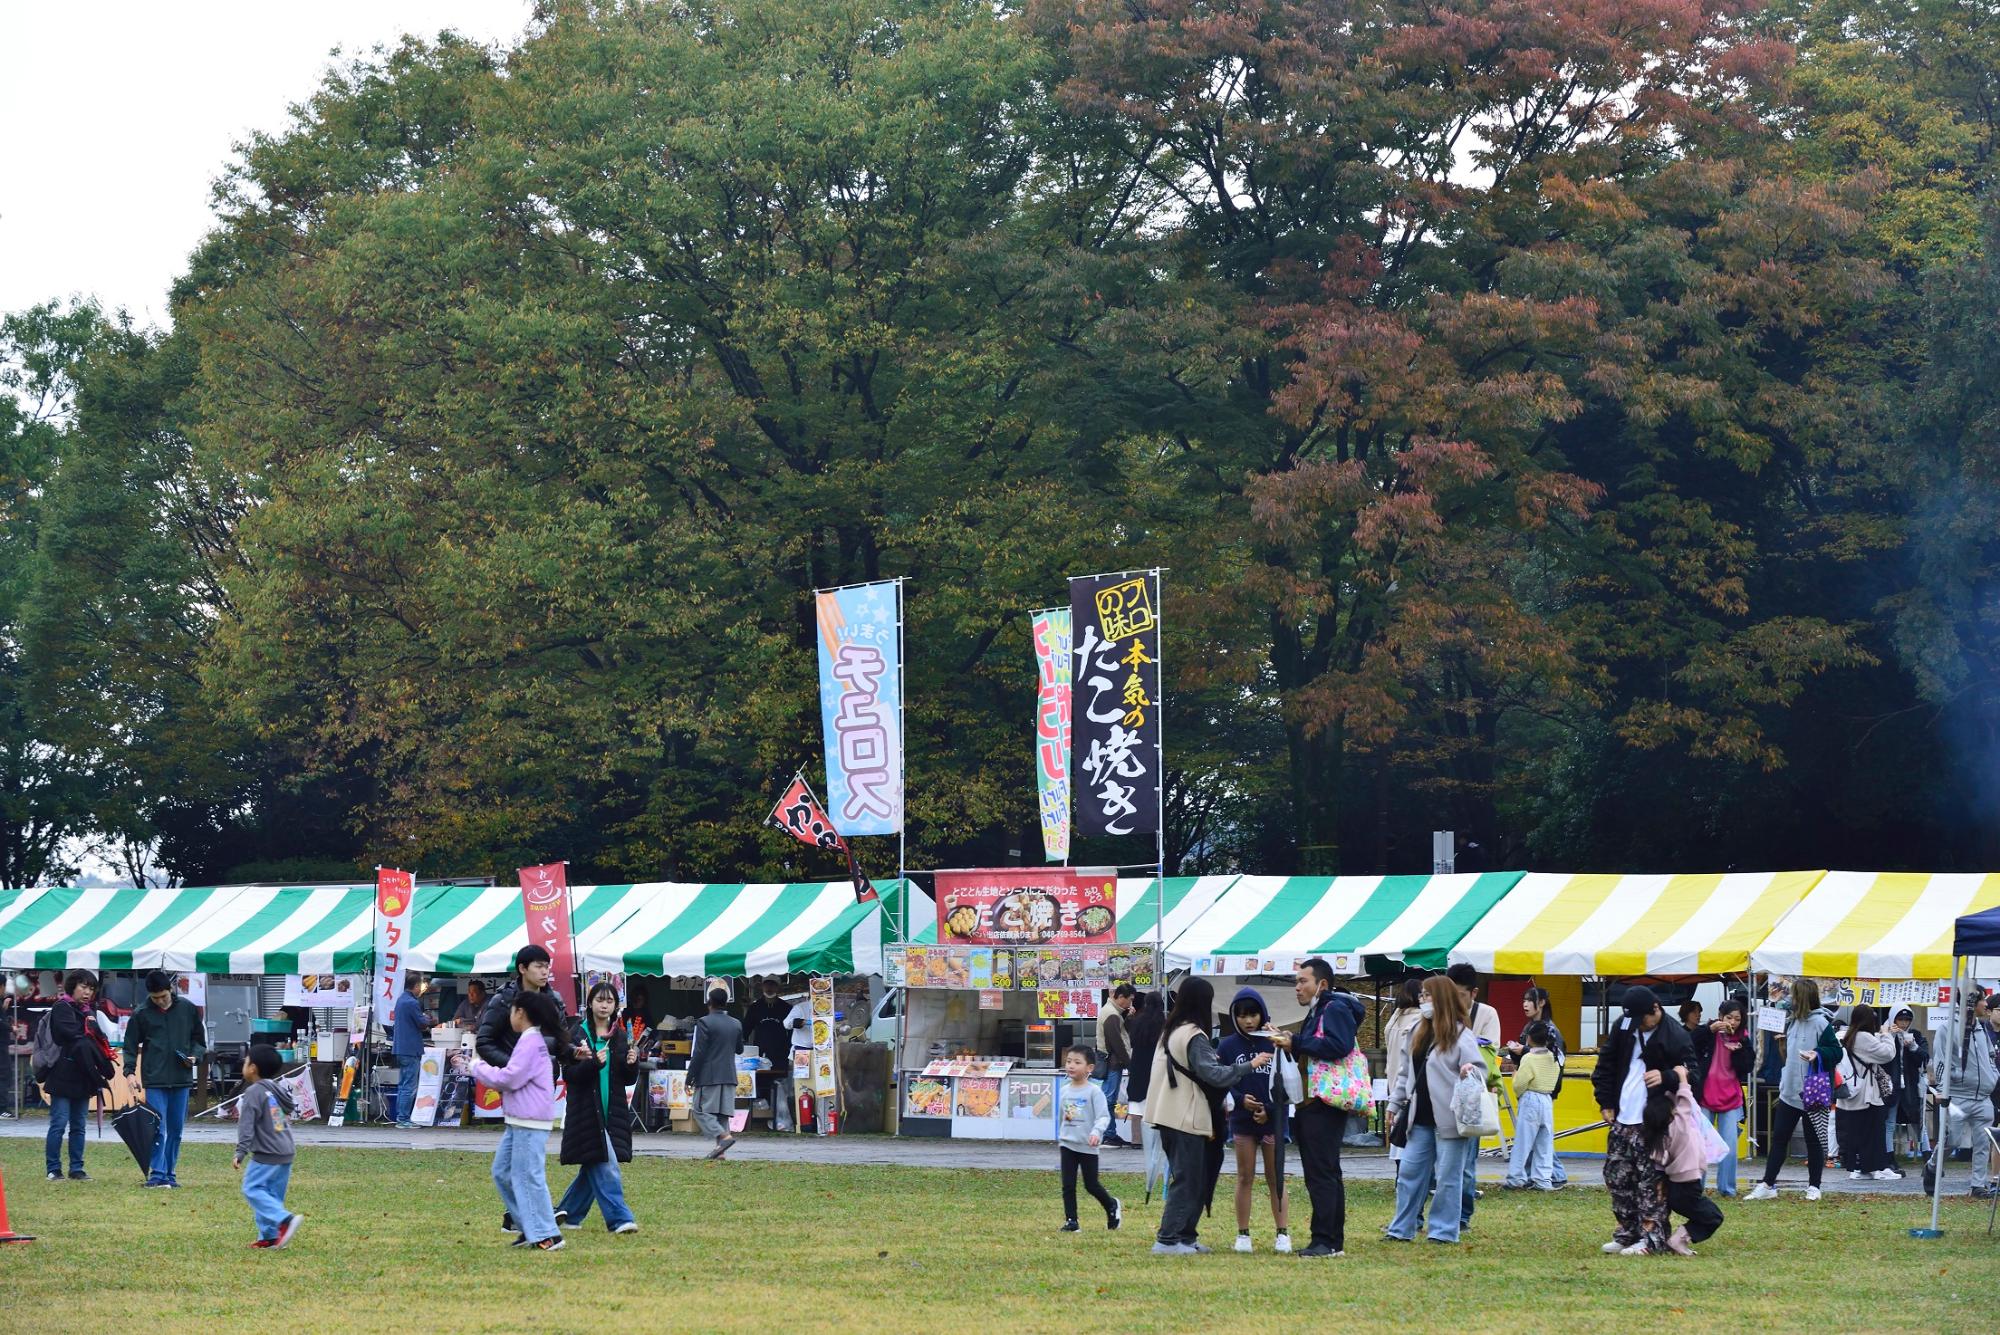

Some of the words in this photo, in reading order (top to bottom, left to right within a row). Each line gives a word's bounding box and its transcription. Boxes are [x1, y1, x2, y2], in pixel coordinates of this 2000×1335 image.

[1101, 589, 1132, 639] の味
[1121, 577, 1151, 630] プロ
[1121, 638, 1152, 728] 本気の
[1073, 625, 1147, 836] たこ焼き
[969, 900, 1080, 932] たこ焼き
[383, 921, 402, 1001] タコス
[1134, 976, 1151, 985] 600
[1021, 980, 1037, 988] 600
[960, 1078, 999, 1090] からあげ
[1009, 1081, 1052, 1096] チュロス
